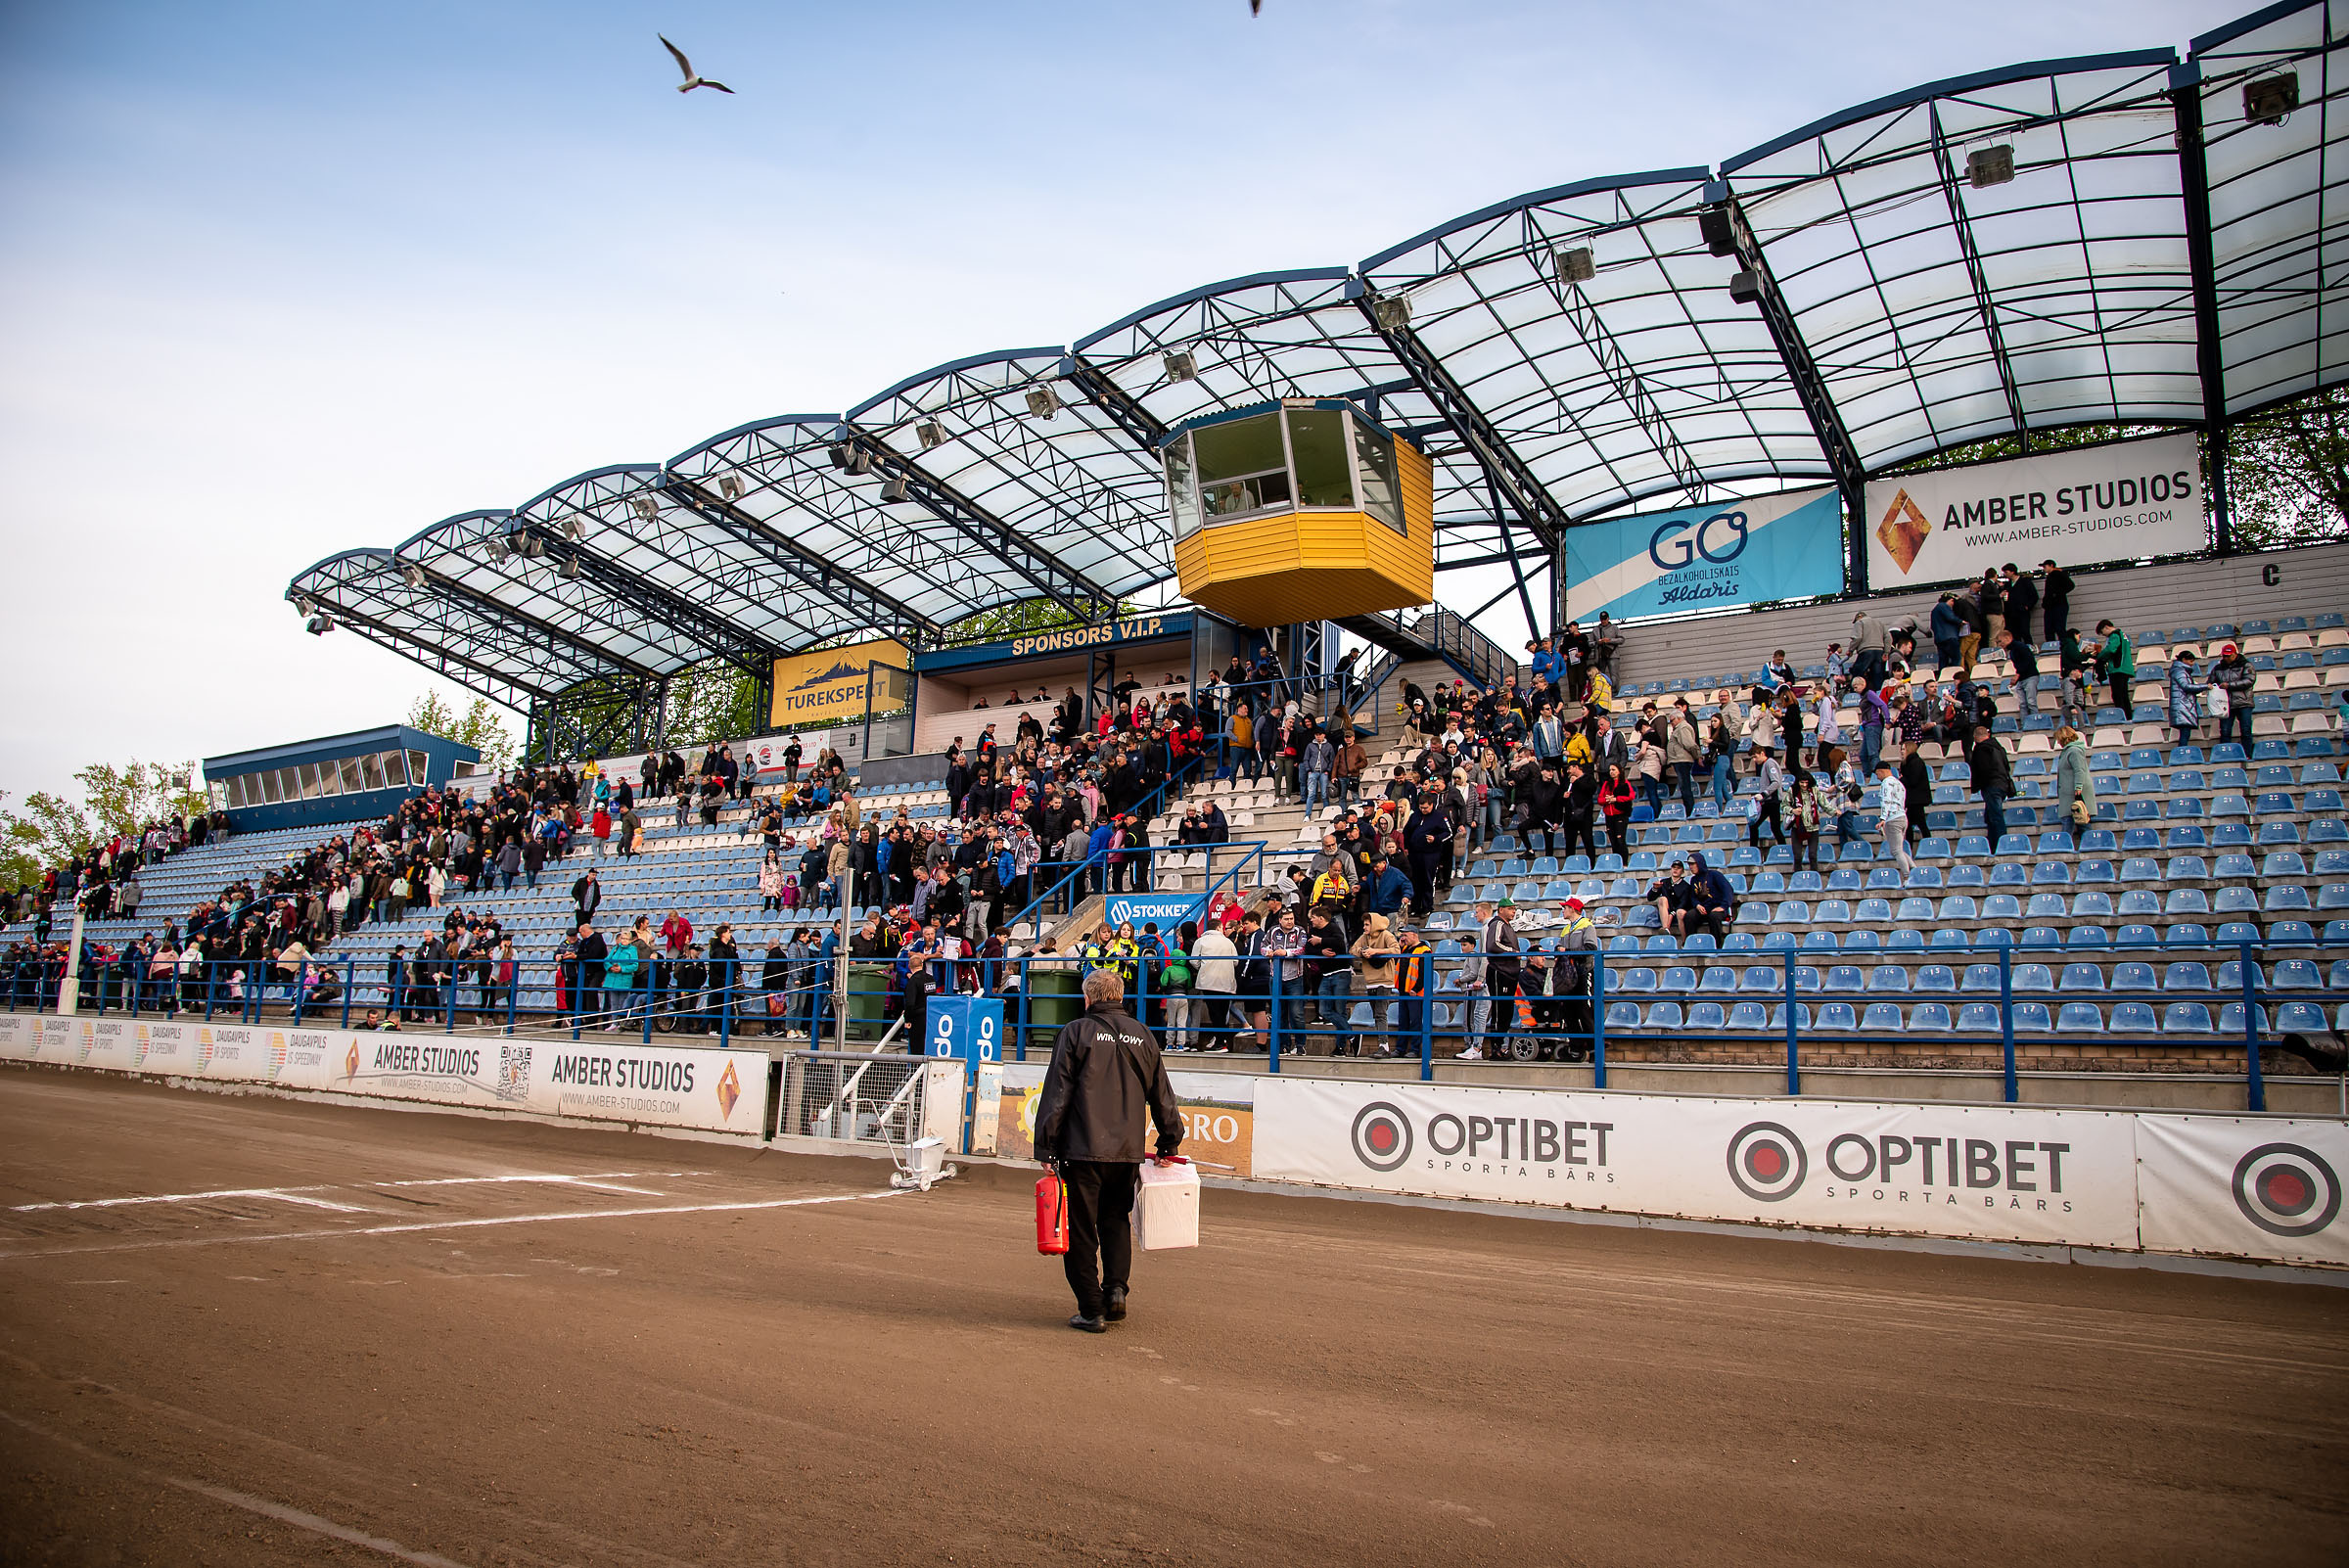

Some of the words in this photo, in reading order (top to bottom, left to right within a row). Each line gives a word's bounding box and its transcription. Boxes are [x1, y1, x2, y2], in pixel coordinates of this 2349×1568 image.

[1942, 491, 2048, 531] AMBER
[2056, 471, 2191, 515] STUDIOS
[1964, 509, 2173, 547] WWW.AMBER-STUDIOS.COM
[1649, 511, 1748, 571] GO
[1658, 565, 1739, 585] BEZALKOHOLISKAIS
[2262, 563, 2280, 586] C
[1658, 580, 1739, 605] Aldaris
[1012, 624, 1113, 656] SPONSORS
[1119, 618, 1164, 639] V.I.P.
[0, 1018, 21, 1029] AUGAVPILS
[45, 1020, 70, 1032] DAUGAVPILS
[96, 1023, 122, 1036] DAUGAVPILS
[152, 1026, 182, 1039] DAUGAVPILS
[98, 1038, 114, 1050] SPORTS
[216, 1030, 251, 1044] DAUGAVPILS
[290, 1034, 327, 1049] DAUGAVPILS
[155, 1042, 177, 1055] SPEEDWAY
[220, 1046, 240, 1060] SPORTS
[288, 1051, 294, 1064] IS
[294, 1051, 322, 1066] SPEEDWAY
[374, 1043, 420, 1072] AMBER
[421, 1046, 481, 1076] STUDIOS
[551, 1054, 612, 1086] AMBER
[616, 1058, 695, 1093] STUDIOS
[381, 1077, 468, 1094] WWW.AMBER-STUDIOS.COM
[562, 1092, 680, 1114] WWW.AMBER-STUDIOS.COM
[1427, 1113, 1614, 1167] OPTIBET
[1427, 1159, 1527, 1176] SPORTA
[1547, 1167, 1614, 1183] BĀRS
[1825, 1132, 2070, 1193] OPTIBET
[1826, 1186, 1958, 1205] SPORTA
[1984, 1194, 2072, 1213] BĀRS
